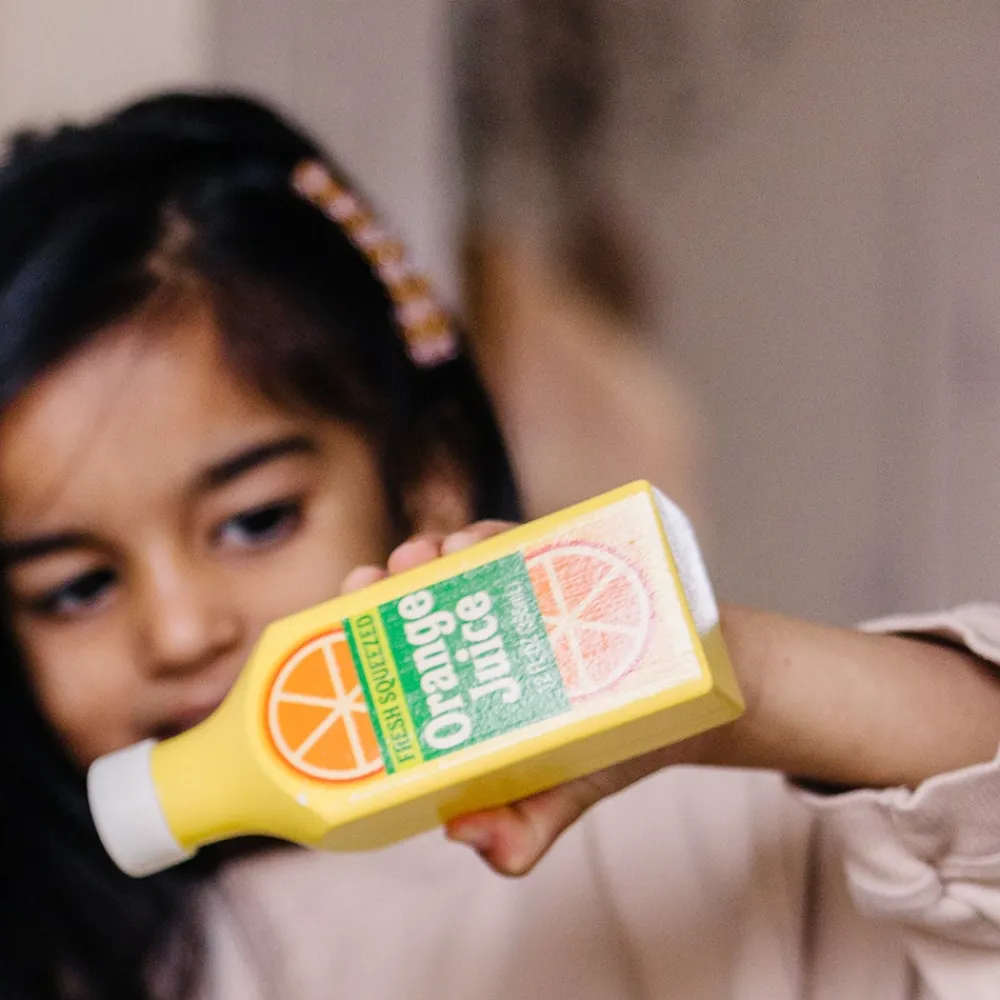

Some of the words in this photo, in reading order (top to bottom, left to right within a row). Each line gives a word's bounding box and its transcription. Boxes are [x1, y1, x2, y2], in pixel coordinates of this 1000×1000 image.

[357, 614, 396, 704] SQUEEZED
[397, 589, 473, 749] Orange
[455, 590, 521, 704] Juice
[383, 706, 415, 763] FRESH
